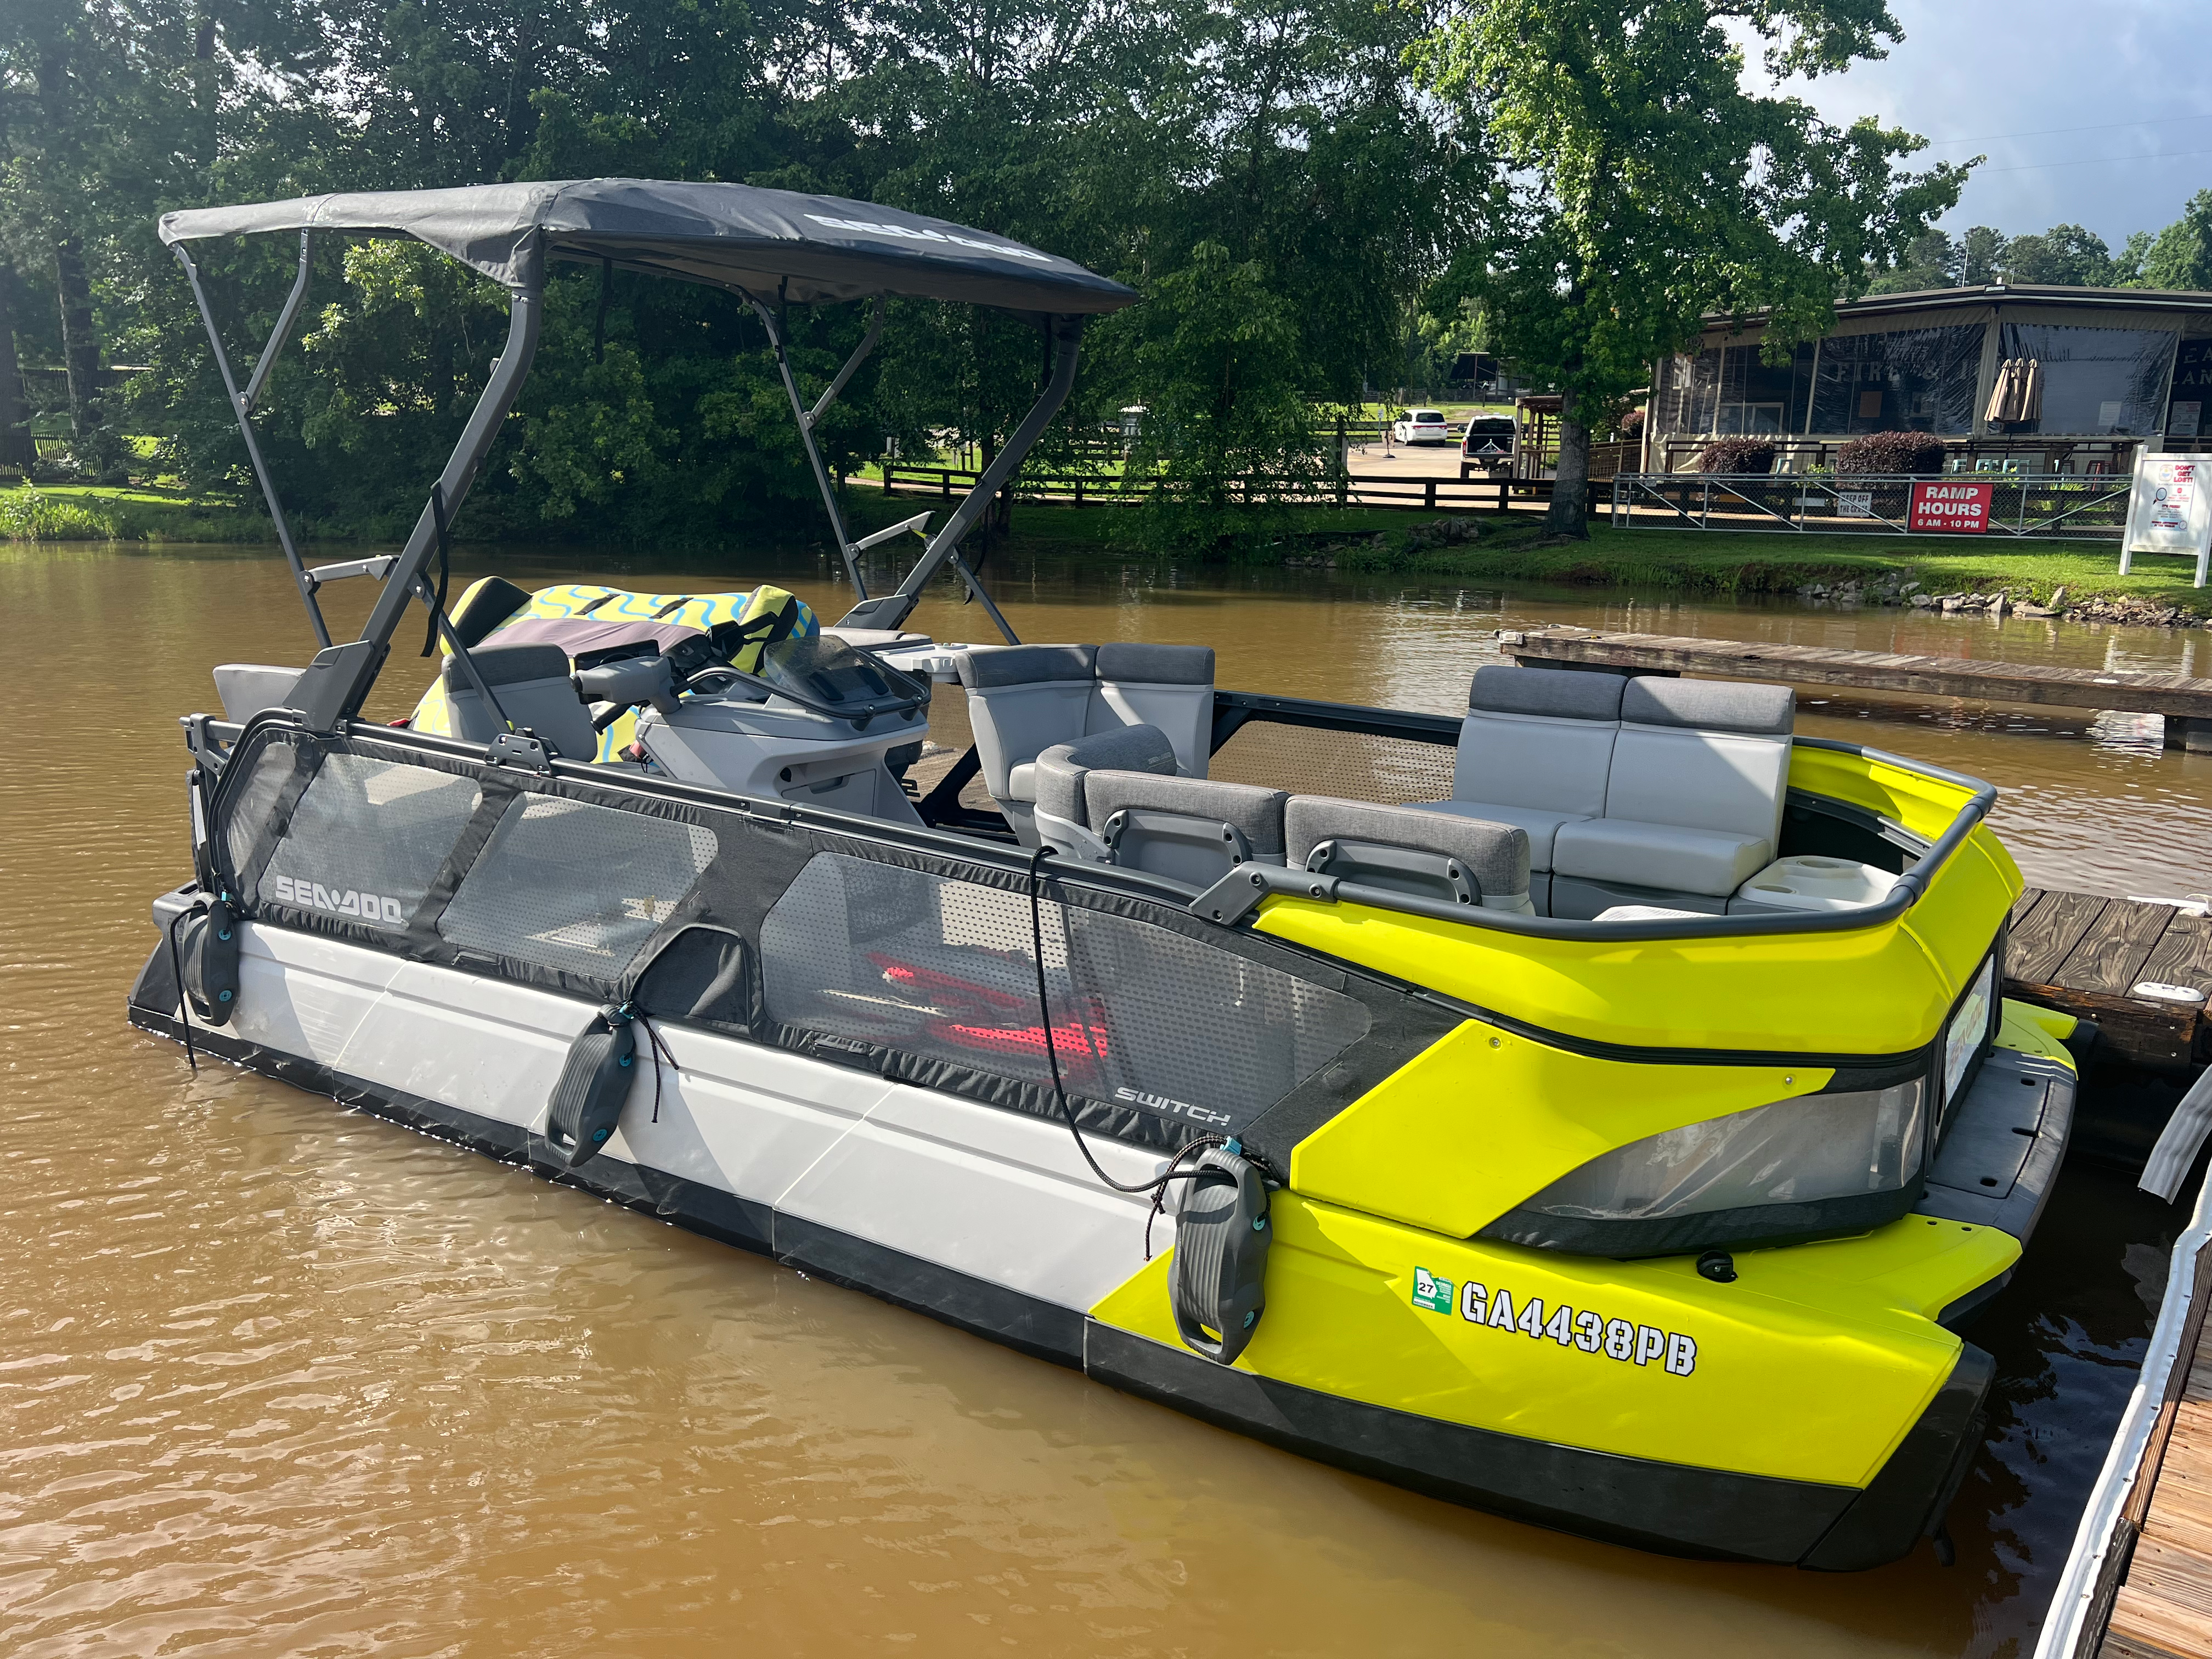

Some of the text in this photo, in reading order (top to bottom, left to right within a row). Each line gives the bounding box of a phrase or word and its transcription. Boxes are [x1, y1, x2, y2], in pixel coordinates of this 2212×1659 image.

[1858, 494, 1869, 503] OFF
[1926, 486, 1978, 500] RAMP
[1839, 505, 1849, 513] THE
[1918, 502, 1982, 516] HOURS
[1964, 520, 1979, 528] PM
[1115, 1086, 1232, 1126] SWITCH
[1419, 1282, 1434, 1293] 27
[1460, 1280, 1697, 1378] GA4438PB
